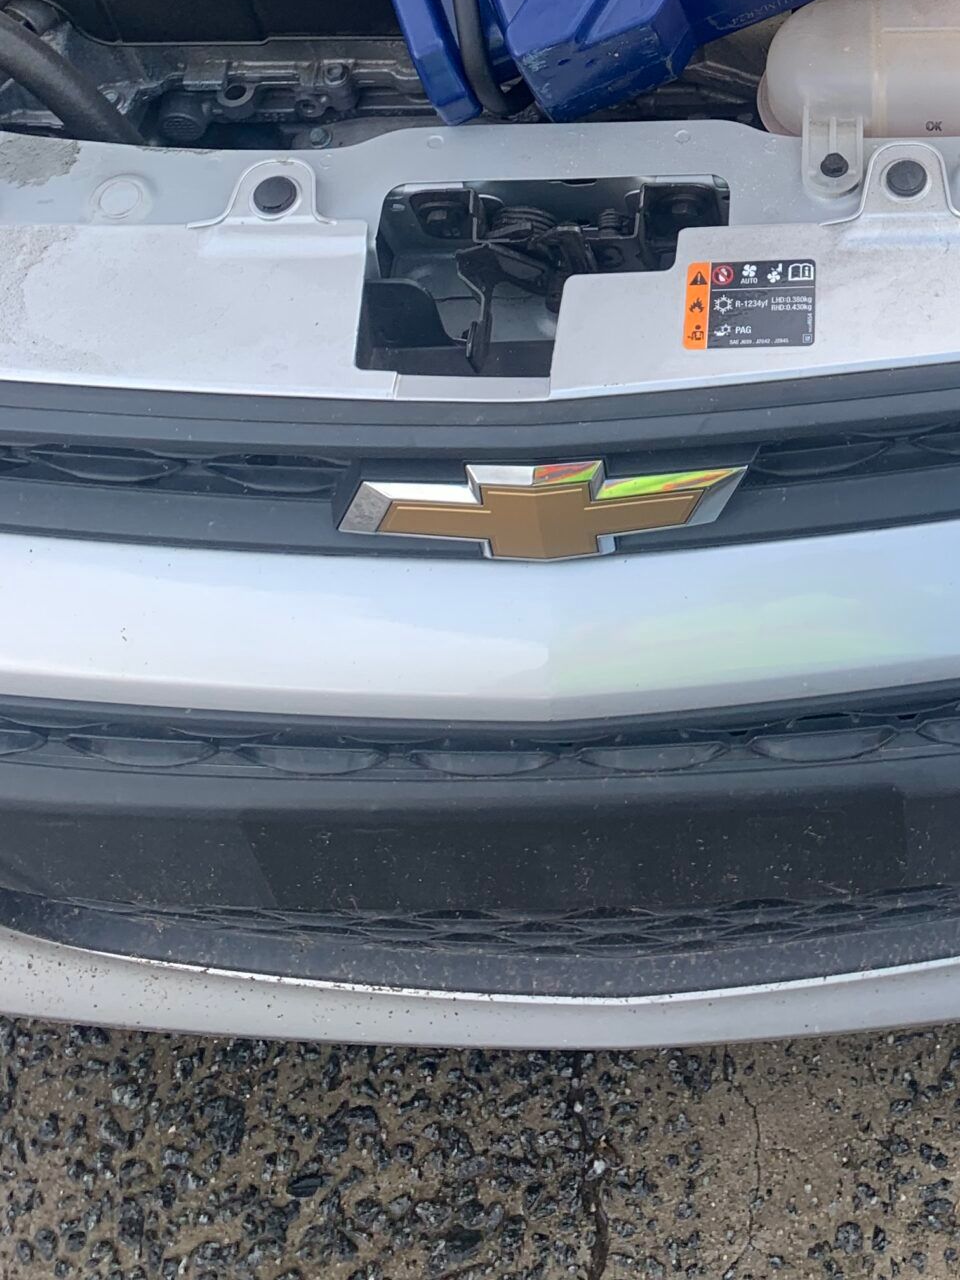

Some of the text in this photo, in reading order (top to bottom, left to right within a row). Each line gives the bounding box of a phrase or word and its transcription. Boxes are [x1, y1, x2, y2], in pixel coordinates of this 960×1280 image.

[925, 120, 943, 132] OK
[740, 277, 758, 285] AUTO
[735, 300, 769, 310] R-1234yf
[735, 325, 752, 335] PAG
